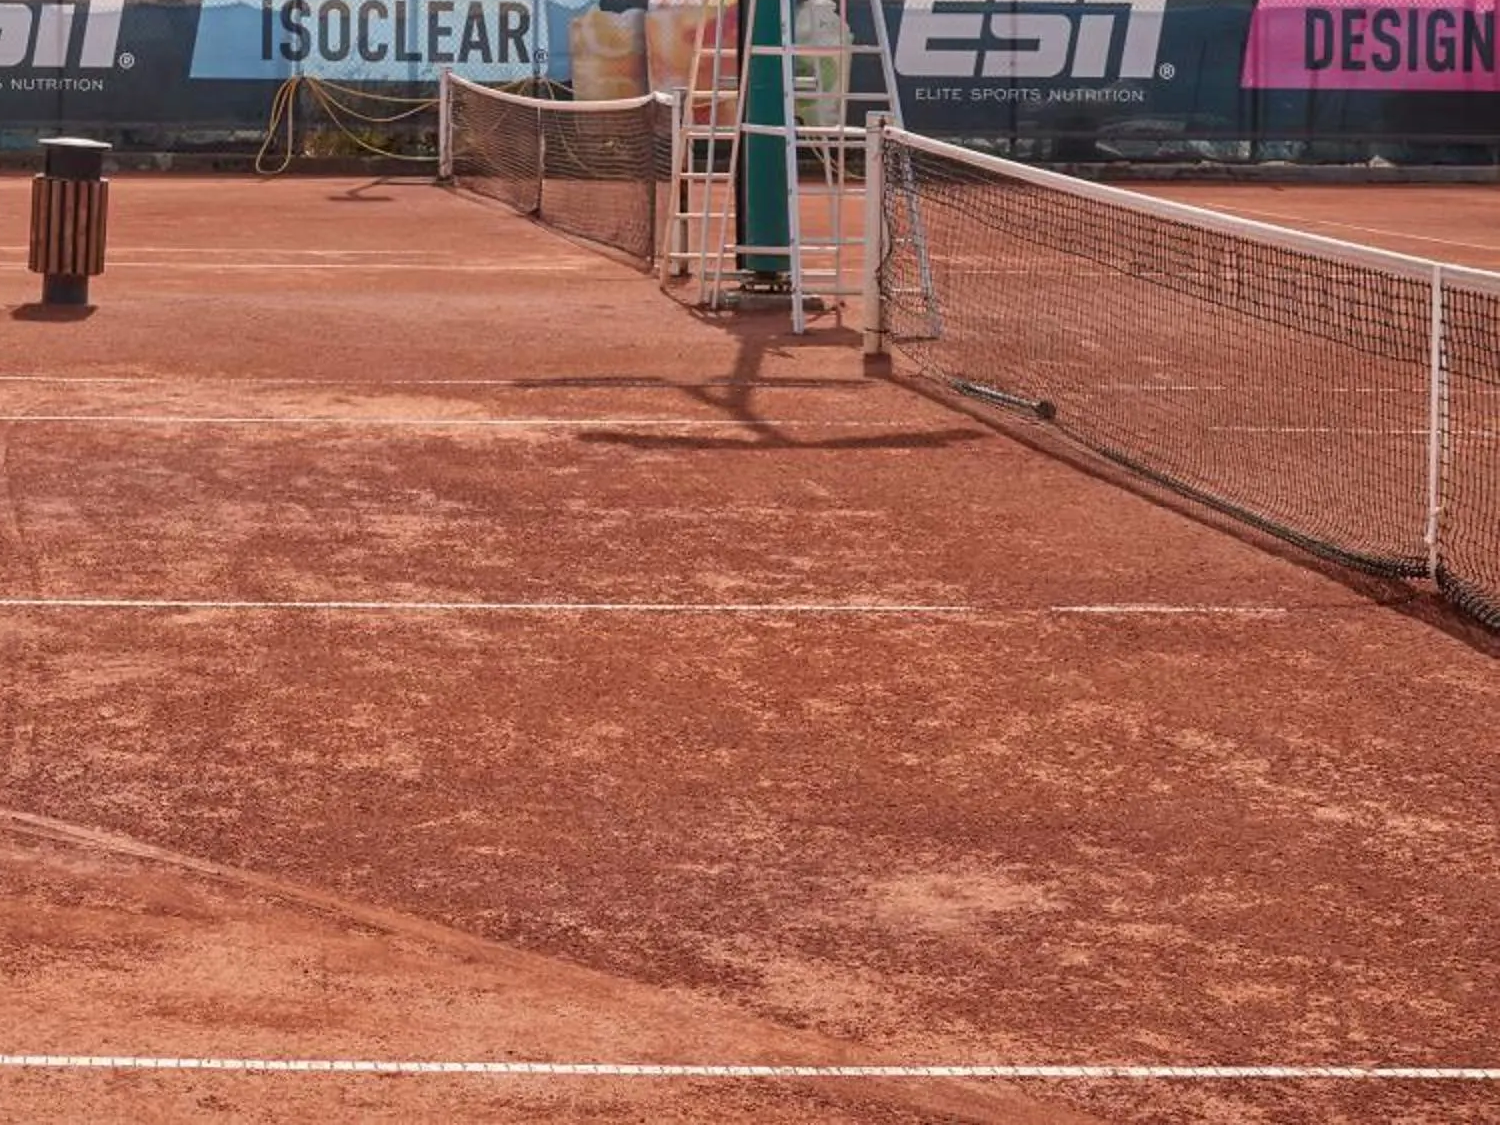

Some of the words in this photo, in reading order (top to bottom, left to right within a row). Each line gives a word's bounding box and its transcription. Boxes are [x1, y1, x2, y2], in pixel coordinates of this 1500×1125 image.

[261, 0, 530, 63] ISOCLEAR
[1304, 8, 1495, 72] DESIGN
[11, 77, 104, 91] NUTRITION
[915, 88, 962, 101] ELITE
[970, 88, 1041, 101] SPORTS
[1050, 89, 1144, 103] NUTRITION
